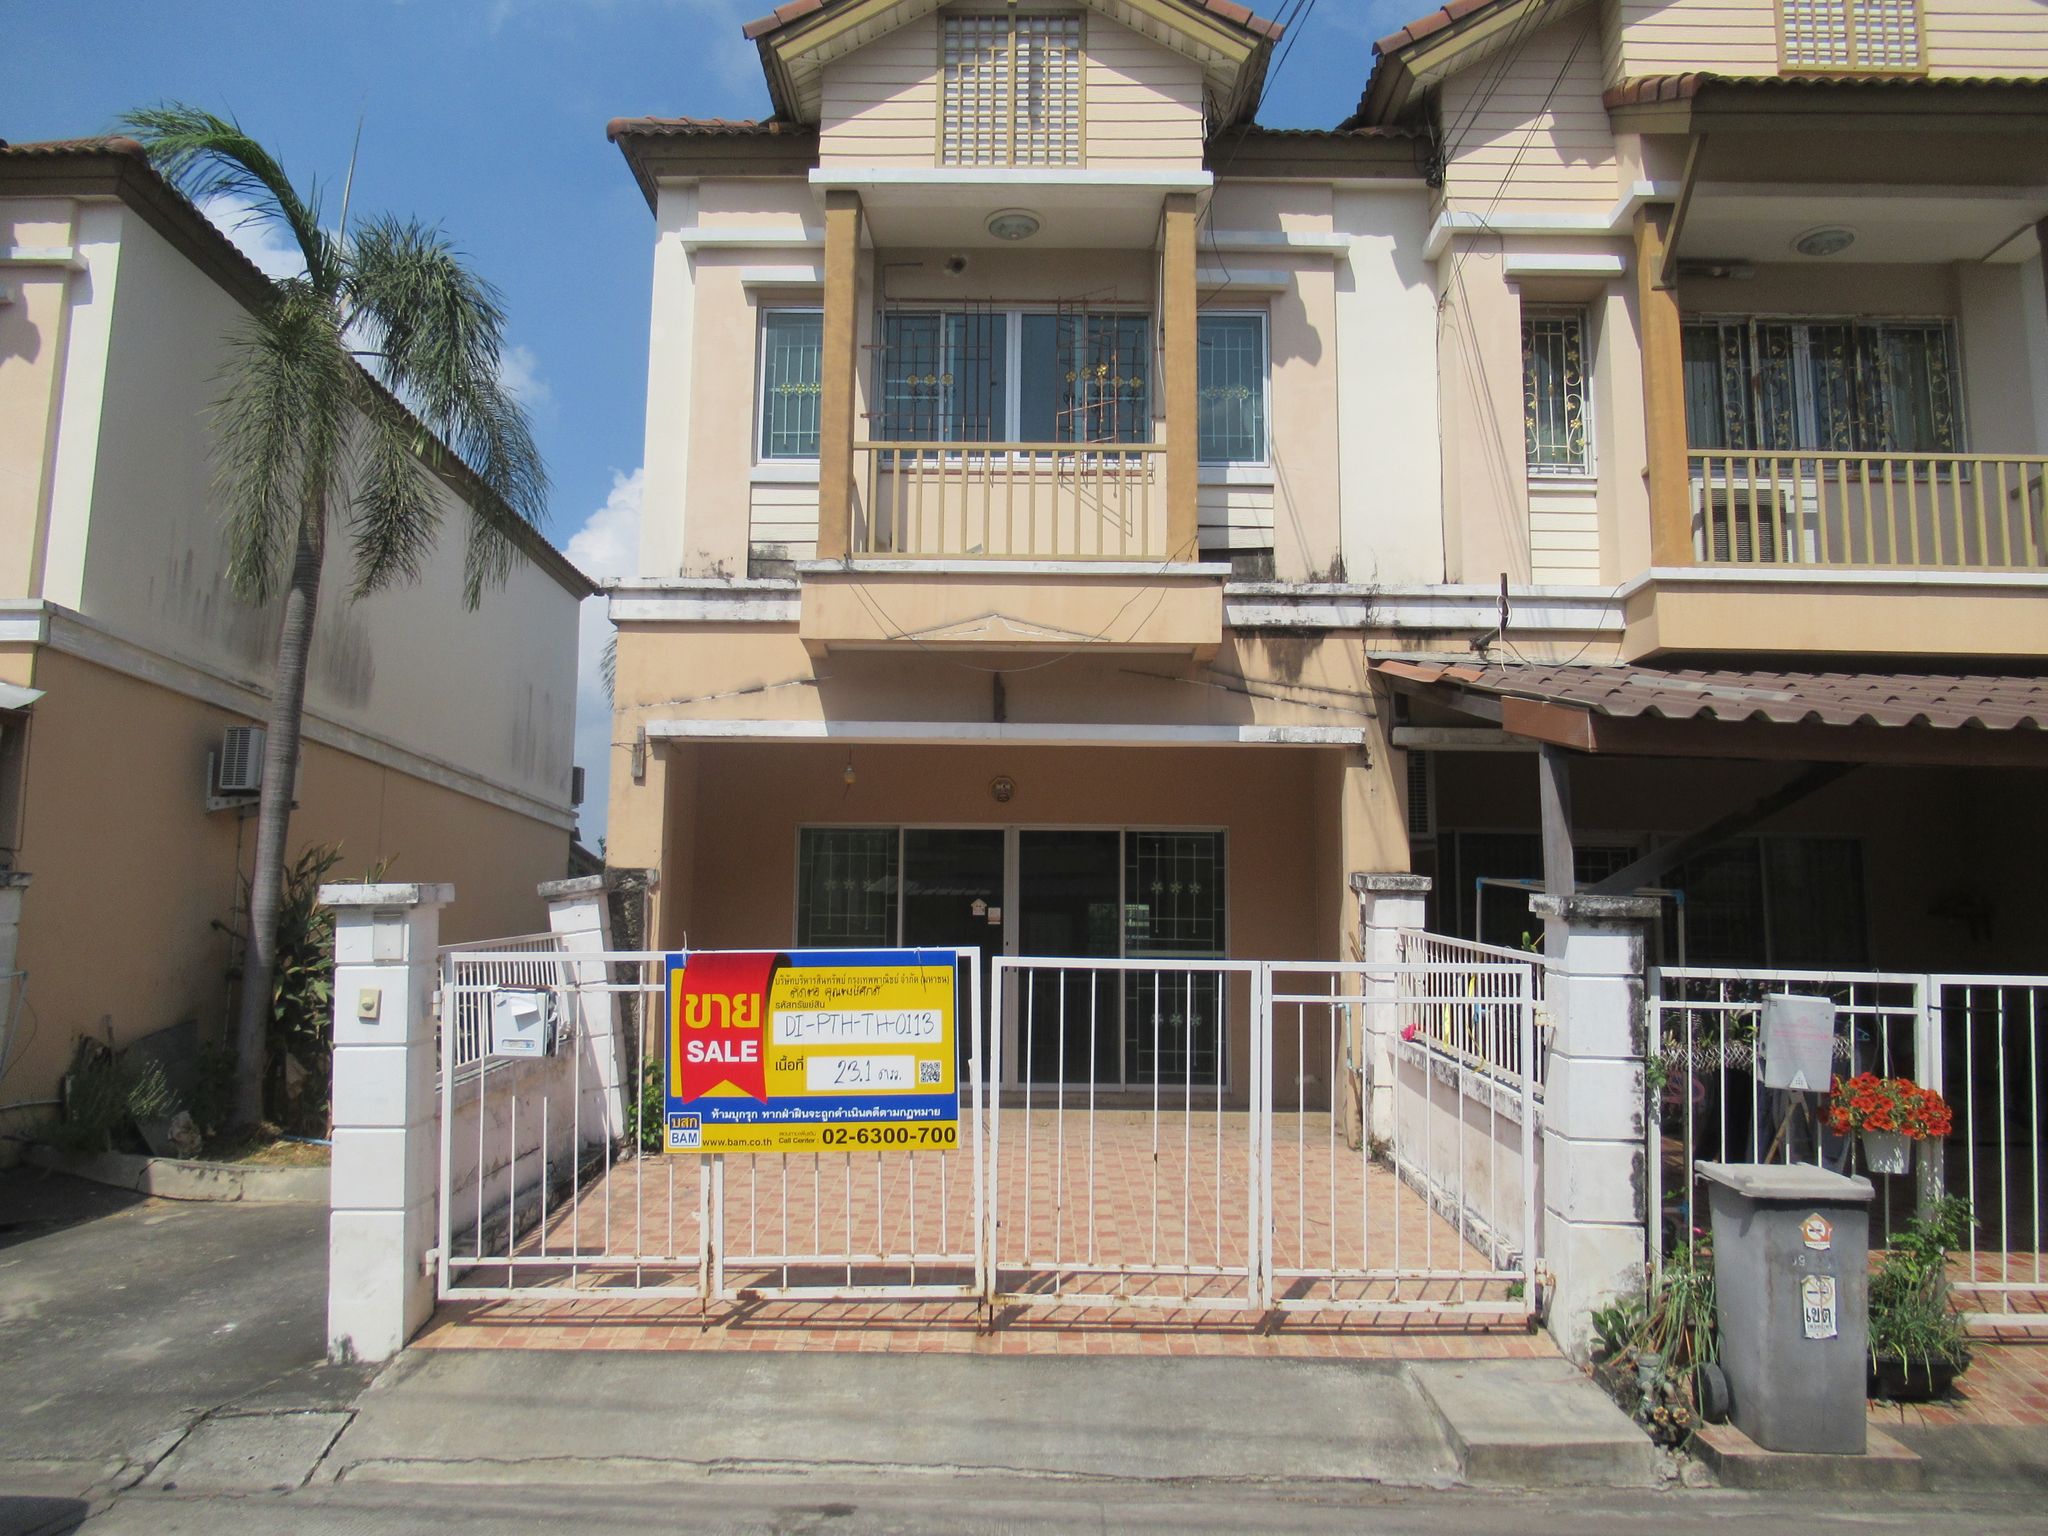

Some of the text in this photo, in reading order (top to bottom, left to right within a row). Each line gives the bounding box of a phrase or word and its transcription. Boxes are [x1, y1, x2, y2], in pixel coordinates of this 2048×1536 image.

[685, 993, 760, 1029] ขาย
[687, 1040, 758, 1063] SALE
[775, 1055, 804, 1071] เนื้อที่
[834, 1059, 871, 1084] 23.1
[671, 1117, 698, 1128] บสก
[711, 1108, 758, 1122] ห้ามบุกรุก
[671, 1132, 698, 1144] BAM
[702, 1137, 772, 1147] www.bam.co.th
[822, 1127, 956, 1145] 02-6300-700
